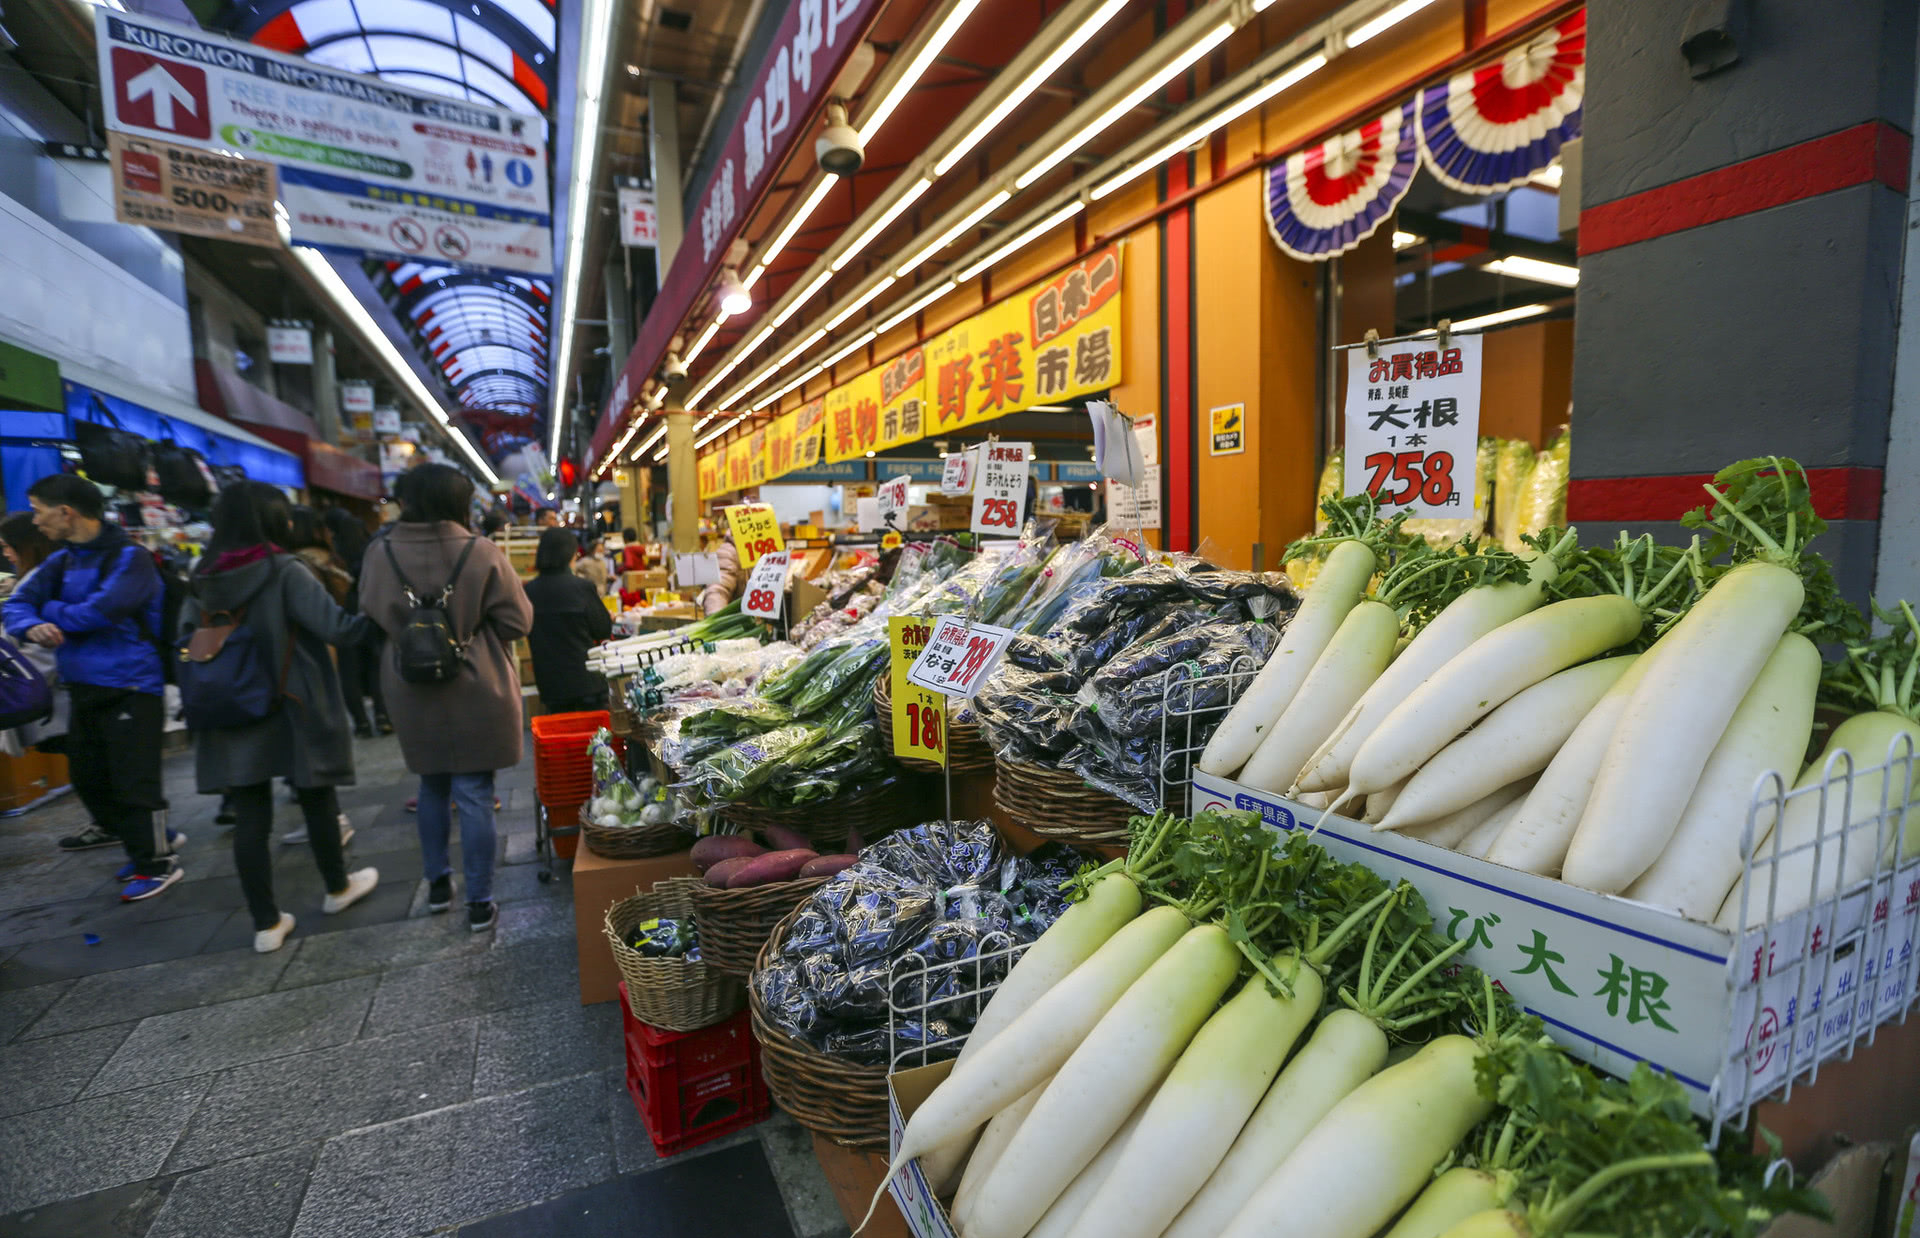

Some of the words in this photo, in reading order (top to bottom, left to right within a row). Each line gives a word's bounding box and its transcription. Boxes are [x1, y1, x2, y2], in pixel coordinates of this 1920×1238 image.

[123, 24, 255, 73] KUROMON
[267, 60, 413, 113] INFORMATION
[422, 101, 495, 130] CENTER
[223, 80, 277, 102] FREE
[230, 99, 281, 126] There
[168, 149, 267, 177] BAGGAGE
[170, 163, 269, 192] STORAGE
[1035, 254, 1117, 342] 日本一
[937, 331, 1025, 425] 野菜
[1037, 326, 1112, 396] 市場
[1369, 348, 1463, 384] お買得品
[884, 399, 920, 441] 市場
[1368, 397, 1459, 431] 大根
[986, 472, 1022, 488] ほうれんそう
[981, 498, 1017, 528] 258
[747, 589, 776, 612] 88
[926, 652, 958, 674] なす
[1240, 798, 1290, 826] 千葉県産
